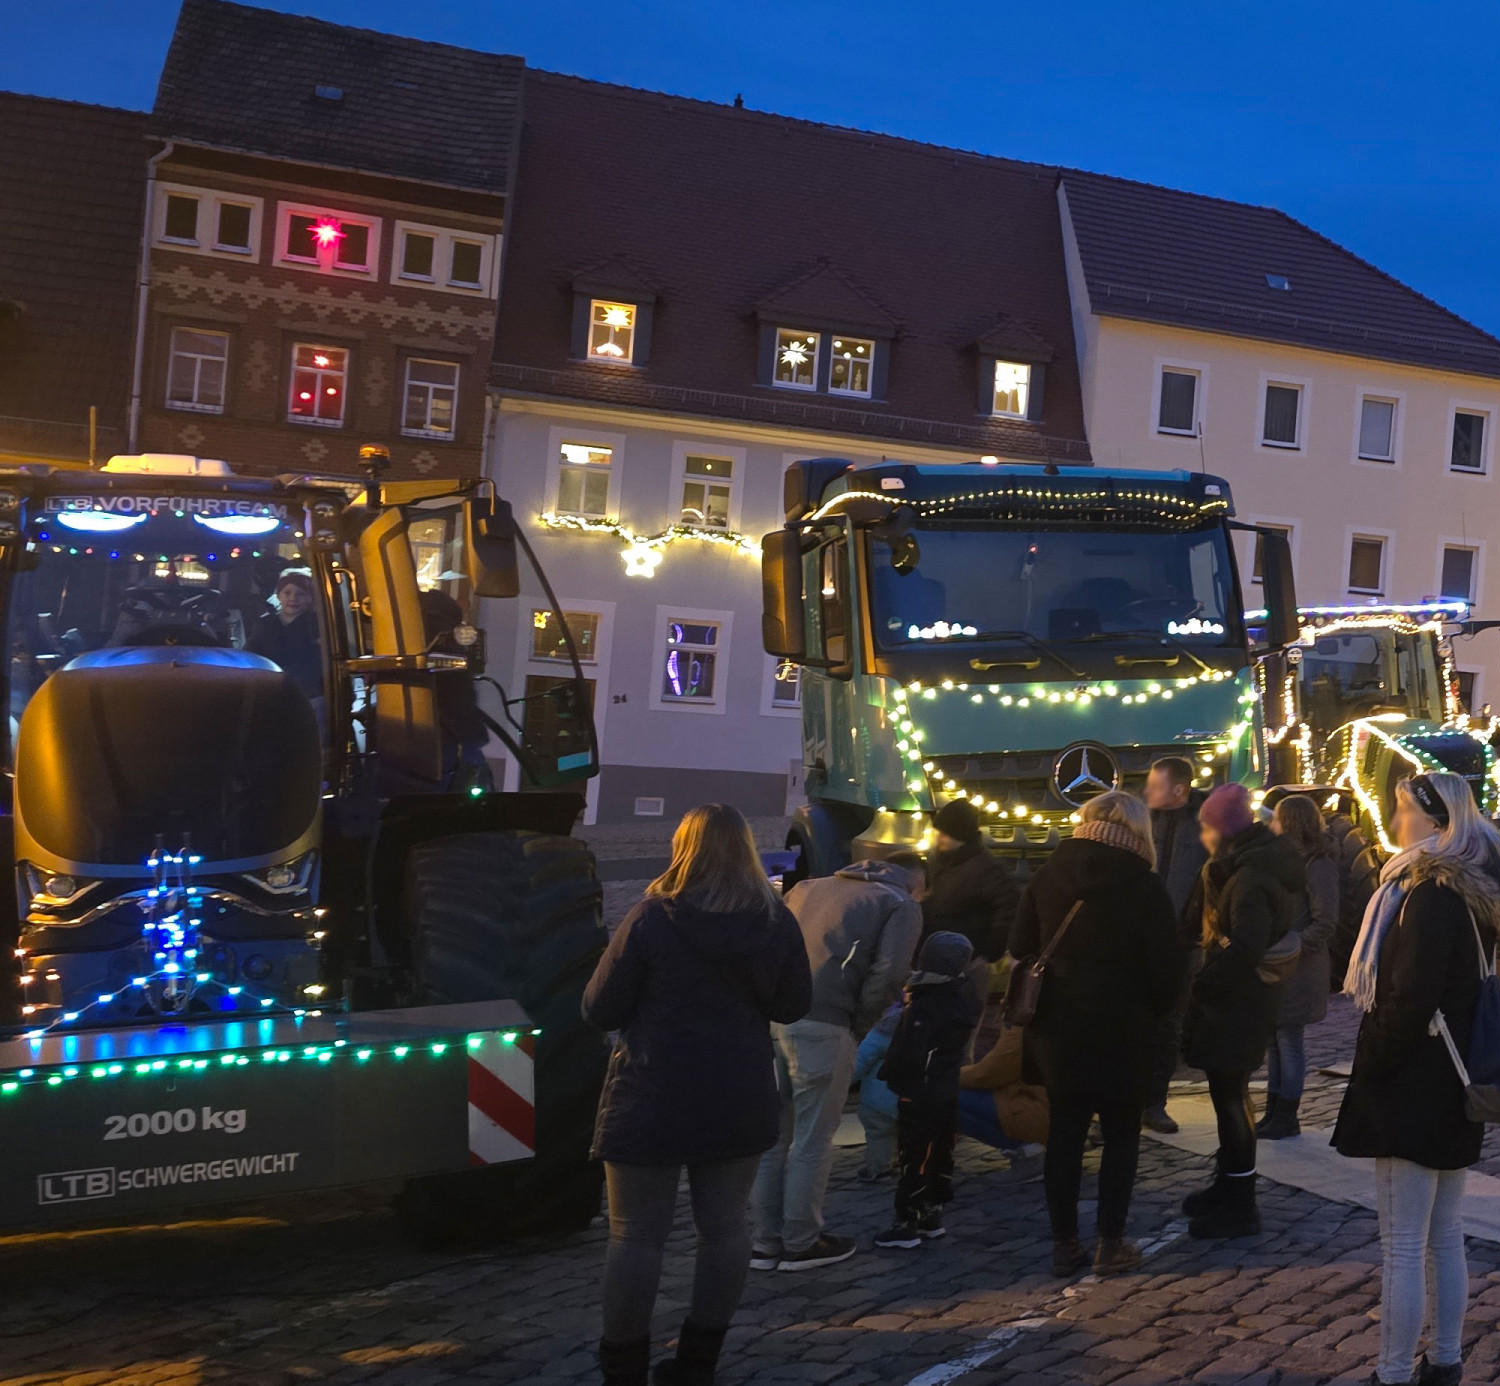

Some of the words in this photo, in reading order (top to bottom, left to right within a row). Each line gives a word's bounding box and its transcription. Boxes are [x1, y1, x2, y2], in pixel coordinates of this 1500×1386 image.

[47, 497, 91, 512] LTB
[98, 496, 288, 519] VORFÜHRTEAM
[612, 694, 628, 705] 24
[104, 1108, 196, 1141] 2000
[202, 1106, 247, 1134] kg
[43, 1171, 111, 1201] LTB
[119, 1152, 299, 1190] SCHWERGEWICHT
